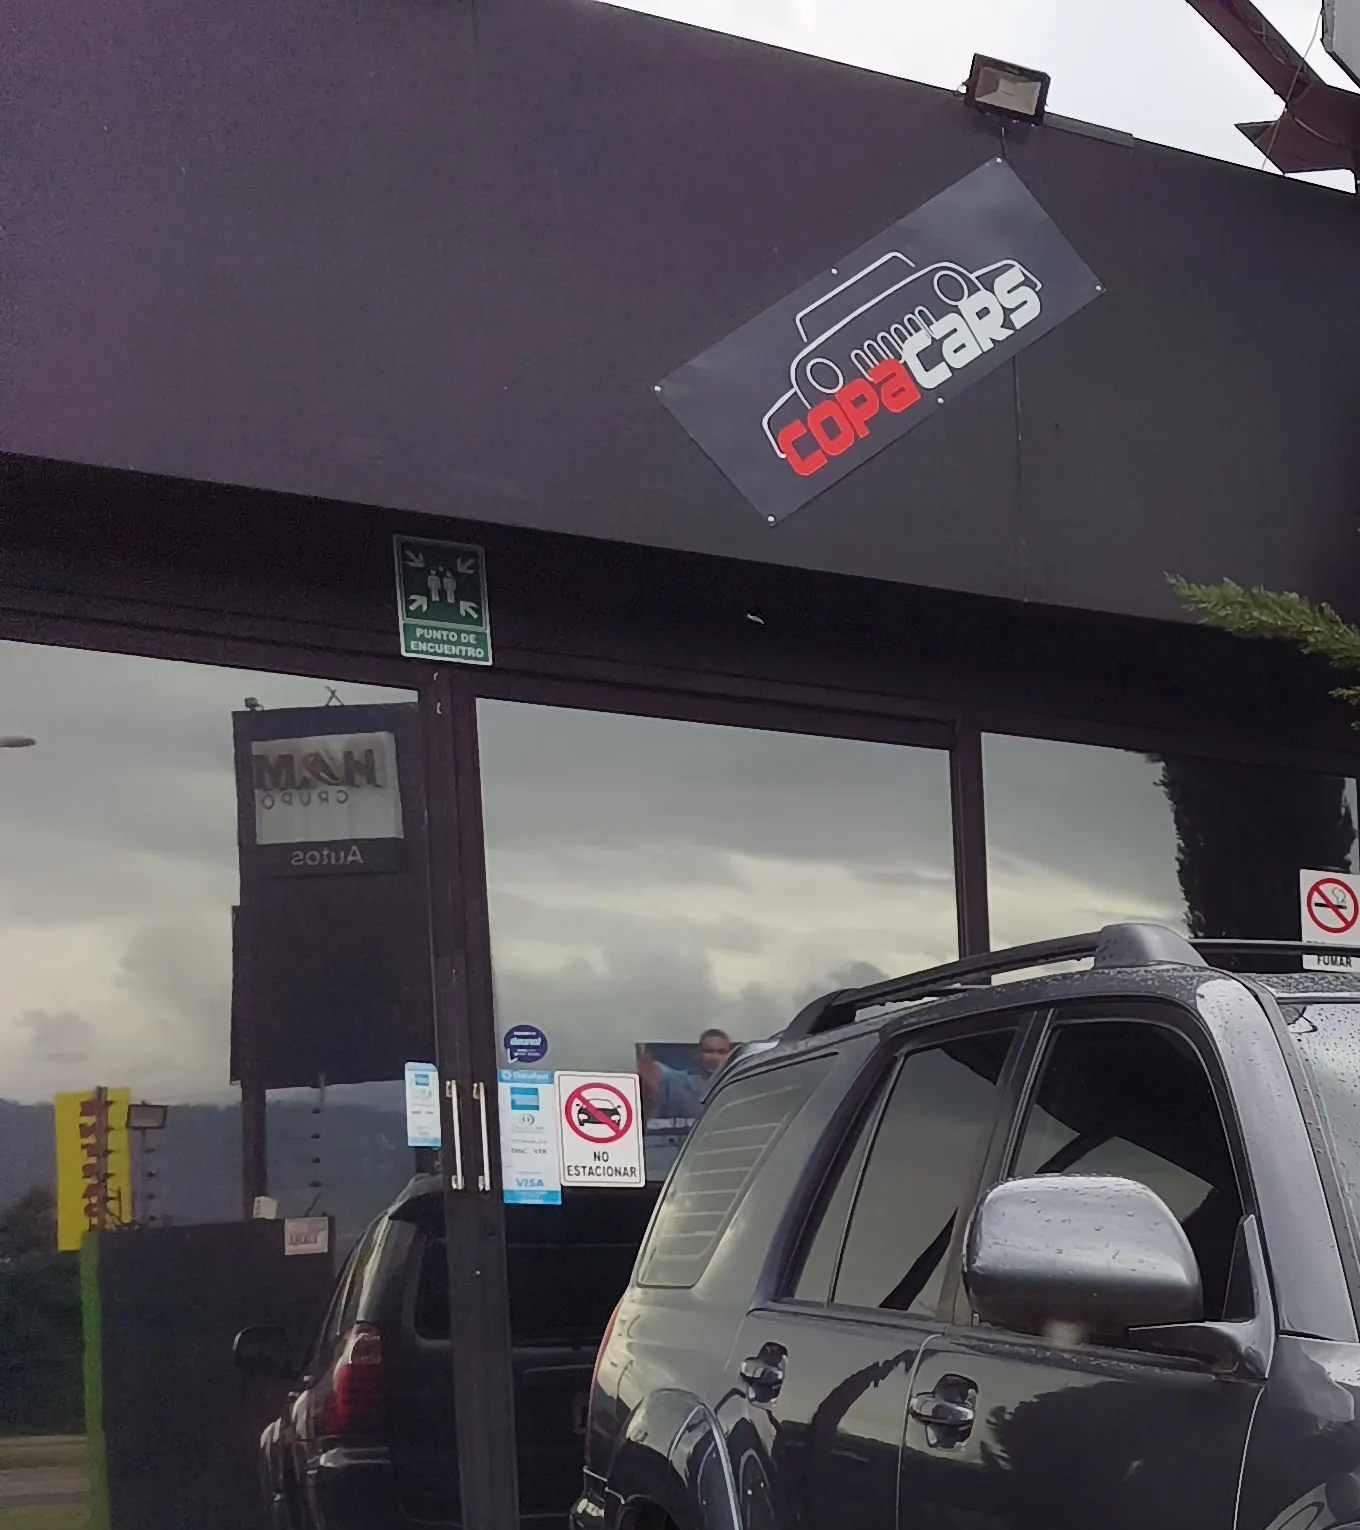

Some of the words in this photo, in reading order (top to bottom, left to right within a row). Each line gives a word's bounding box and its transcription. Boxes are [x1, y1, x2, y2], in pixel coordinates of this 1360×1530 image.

[415, 627, 457, 642] PUNTO
[461, 633, 477, 644] DE
[410, 640, 485, 658] ENCUENTRO
[1316, 955, 1353, 968] FUMAR
[593, 1151, 609, 1163] NO
[566, 1165, 637, 1178] ESTACIONAR
[515, 1178, 544, 1188] VISA
